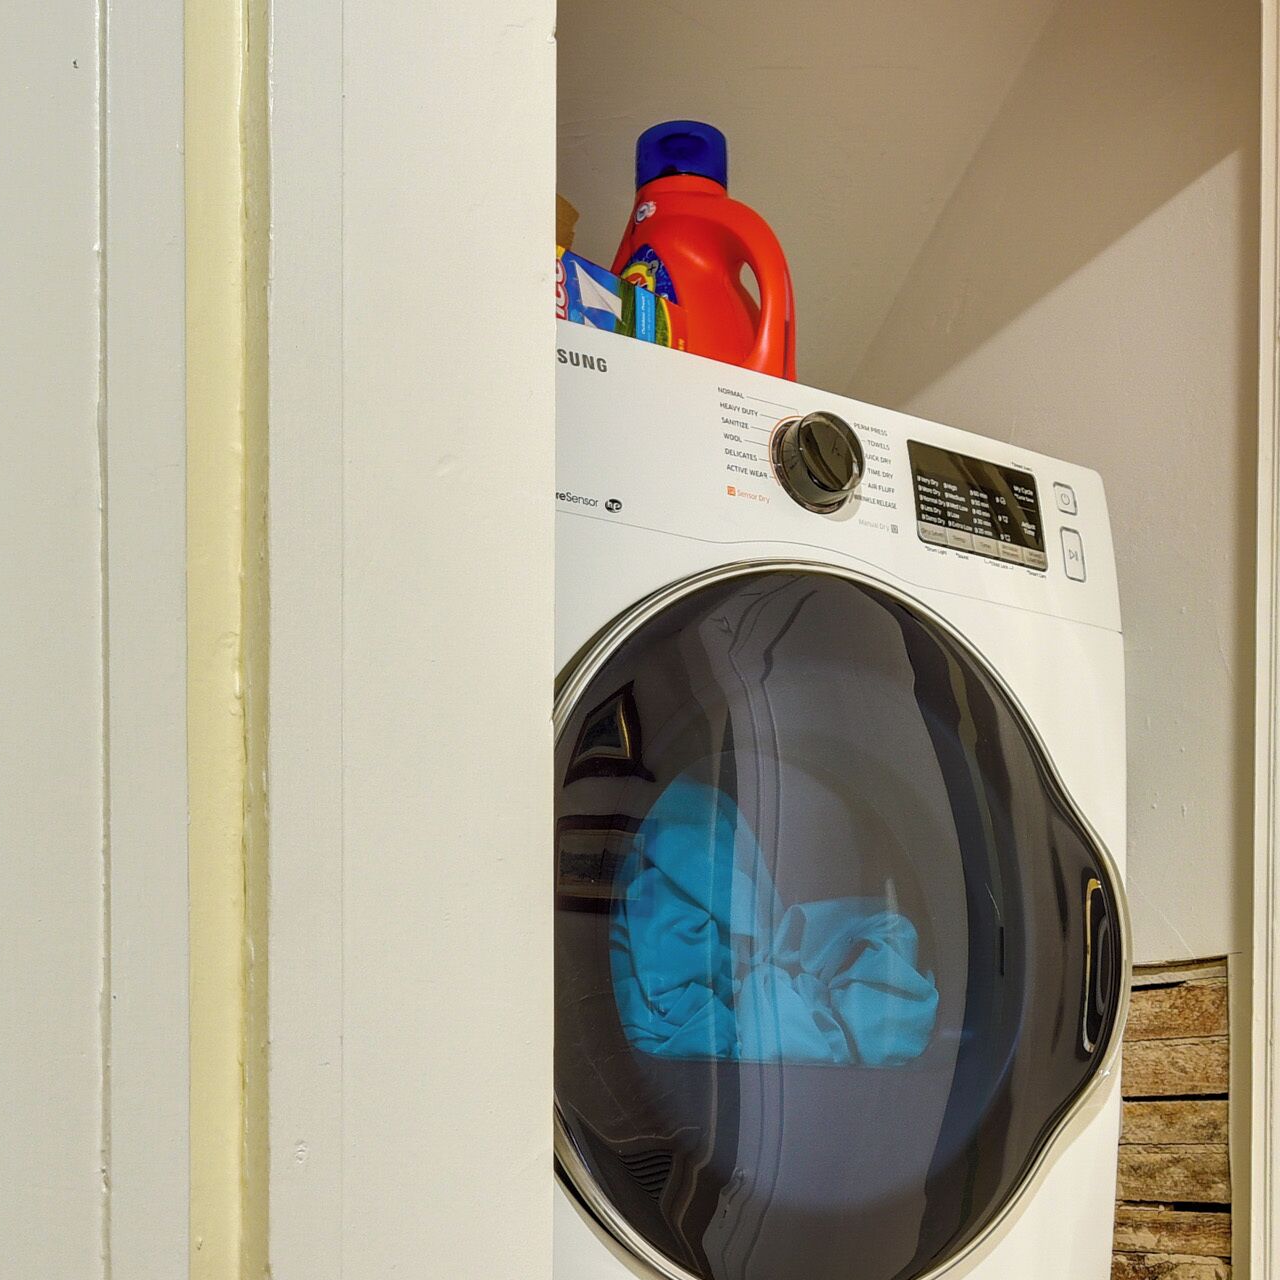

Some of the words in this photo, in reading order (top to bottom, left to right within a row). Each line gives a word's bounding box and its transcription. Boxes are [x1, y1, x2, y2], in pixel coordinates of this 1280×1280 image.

[557, 348, 607, 372] SUNG
[718, 386, 744, 399] NORMAL
[719, 402, 740, 413] HEAVY
[742, 406, 758, 417] DUTY
[721, 417, 750, 430] SANITIZE
[854, 422, 869, 432] PERM
[870, 427, 888, 437] PRESS
[723, 433, 742, 443] WOOL
[867, 440, 890, 451] TOWELS
[725, 448, 758, 462] DELICATES
[727, 464, 748, 476] ACTIVE
[749, 469, 768, 479] WEAR
[867, 468, 881, 476] TIME
[882, 471, 893, 480] DRY
[868, 482, 877, 490] AIR
[878, 485, 895, 494] FLUFF
[930, 479, 938, 487] Dry
[737, 489, 757, 500] Sensor
[758, 493, 770, 504] Dry
[949, 493, 965, 502] Medium
[1021, 487, 1033, 496] Cycle
[877, 500, 897, 510] RELEASE
[923, 496, 938, 504] Normal
[859, 519, 879, 529] Manual
[880, 523, 889, 532] Dry
[937, 517, 945, 526] Dry
